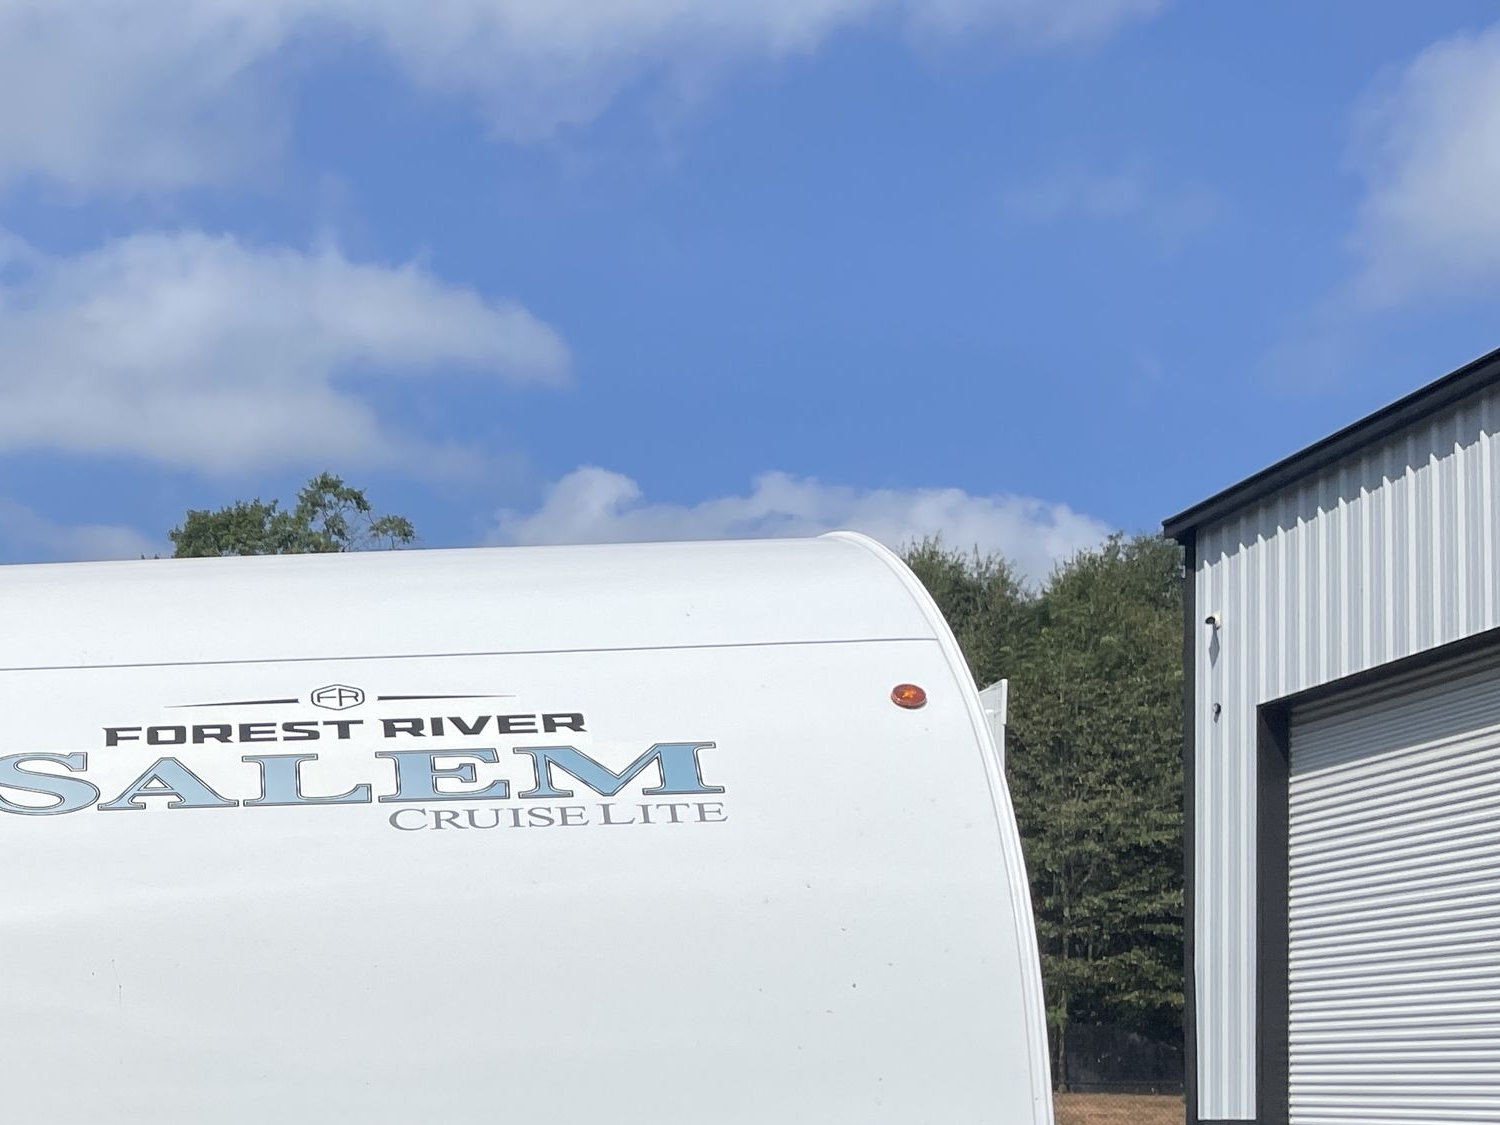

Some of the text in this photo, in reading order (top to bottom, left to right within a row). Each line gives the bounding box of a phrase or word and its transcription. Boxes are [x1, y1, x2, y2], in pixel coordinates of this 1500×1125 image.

[101, 712, 588, 747] FOREST RIVER
[388, 802, 730, 831] CRUISE LITE
